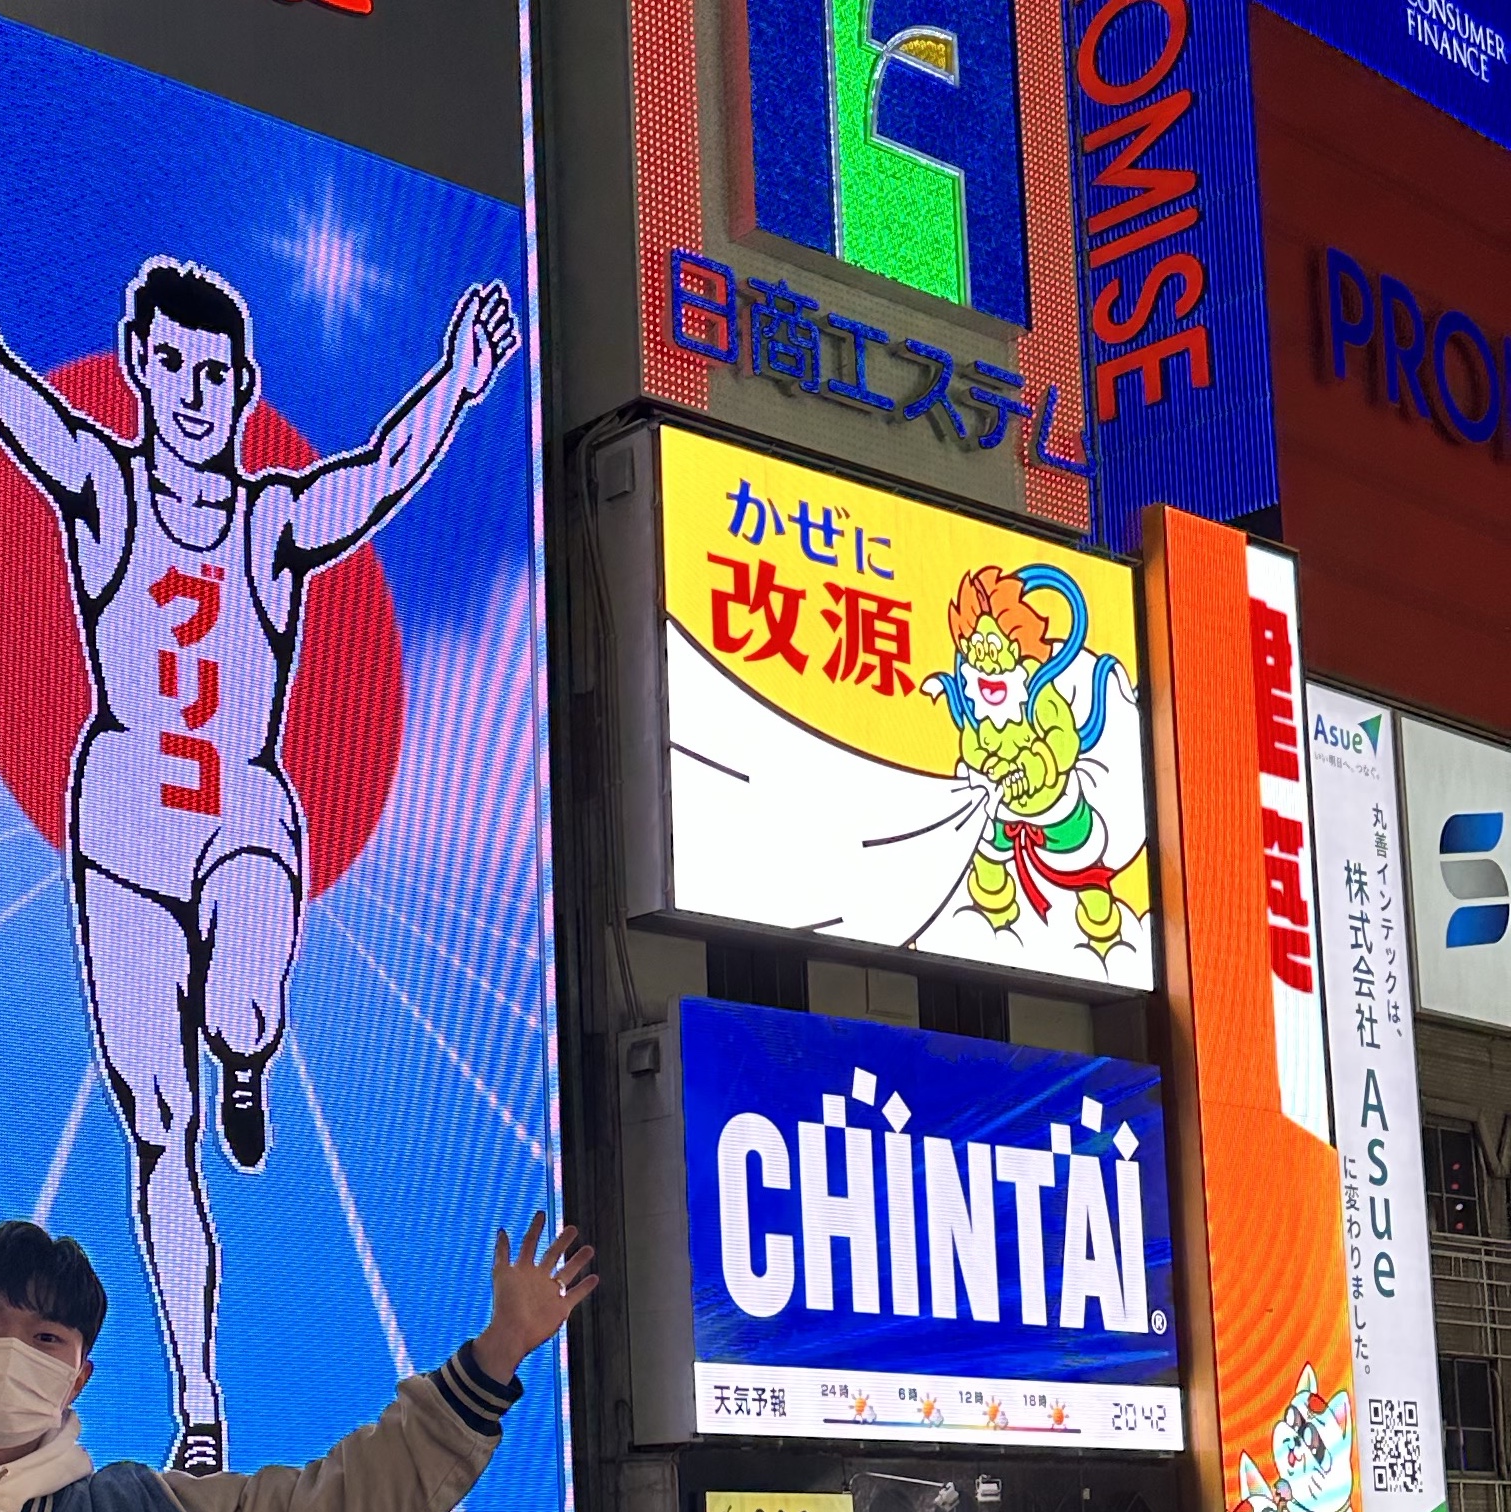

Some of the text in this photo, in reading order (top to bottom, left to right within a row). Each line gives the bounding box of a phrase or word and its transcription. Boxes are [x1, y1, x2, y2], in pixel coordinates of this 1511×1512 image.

[1406, 8, 1489, 83] FINANCE
[1408, 0, 1508, 64] ONSUMER
[1327, 246, 1511, 443] PRO
[725, 477, 895, 580] かぜに
[148, 563, 224, 817] グリコ
[706, 551, 917, 698] 改源
[1314, 714, 1363, 754] Asue
[1343, 860, 1381, 1050] 株式会社
[717, 1067, 1149, 1333] CHINTAI
[1343, 1155, 1371, 1377] に変わりました。
[713, 1384, 787, 1418] 天気予報
[820, 1384, 849, 1399] 24時
[898, 1388, 918, 1402] 6時
[958, 1390, 984, 1405] 12時
[1022, 1394, 1047, 1408] 18時
